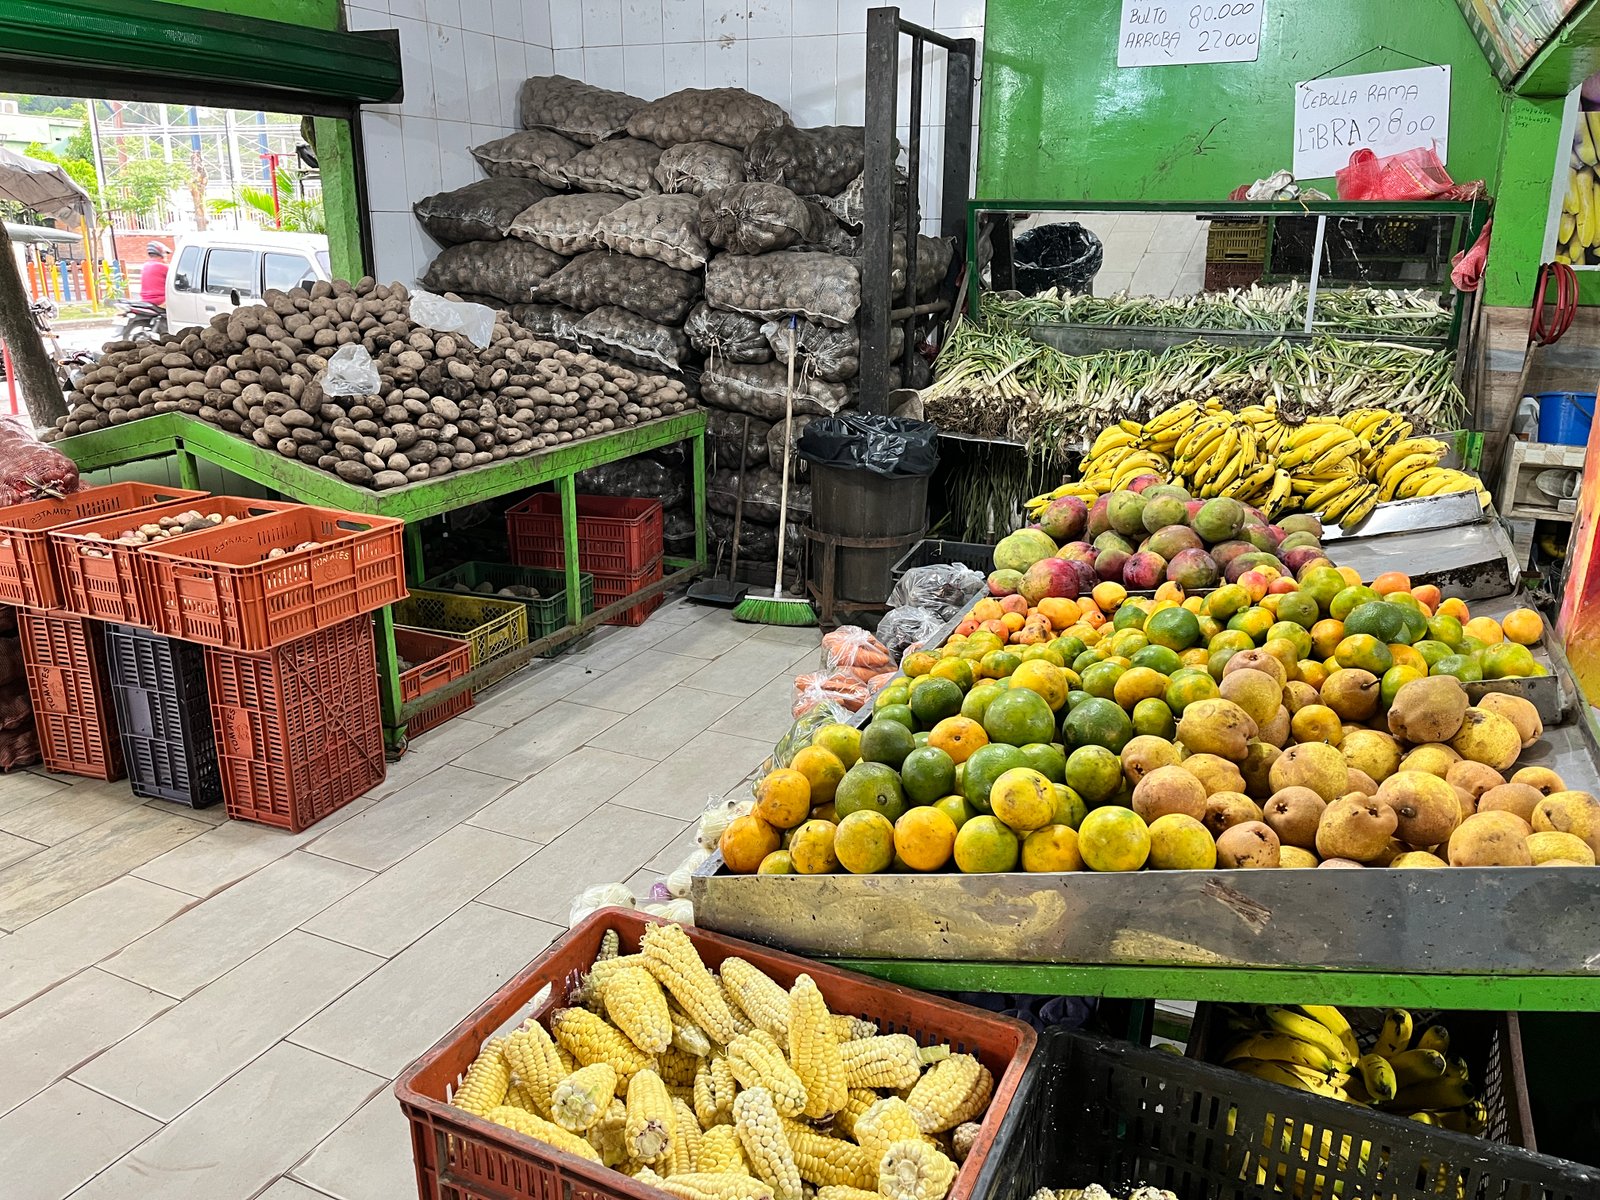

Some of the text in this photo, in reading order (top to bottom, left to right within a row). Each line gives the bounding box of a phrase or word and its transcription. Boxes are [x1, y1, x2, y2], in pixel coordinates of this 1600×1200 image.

[1129, 3, 1255, 29] BULTO 80.000
[1125, 29, 1257, 52] ARROBA 22000
[1302, 84, 1419, 110] CEBOLLA RAMA
[1367, 107, 1436, 143] 2800
[41, 666, 56, 709] TOMATES
[226, 708, 240, 752] TOMATES
